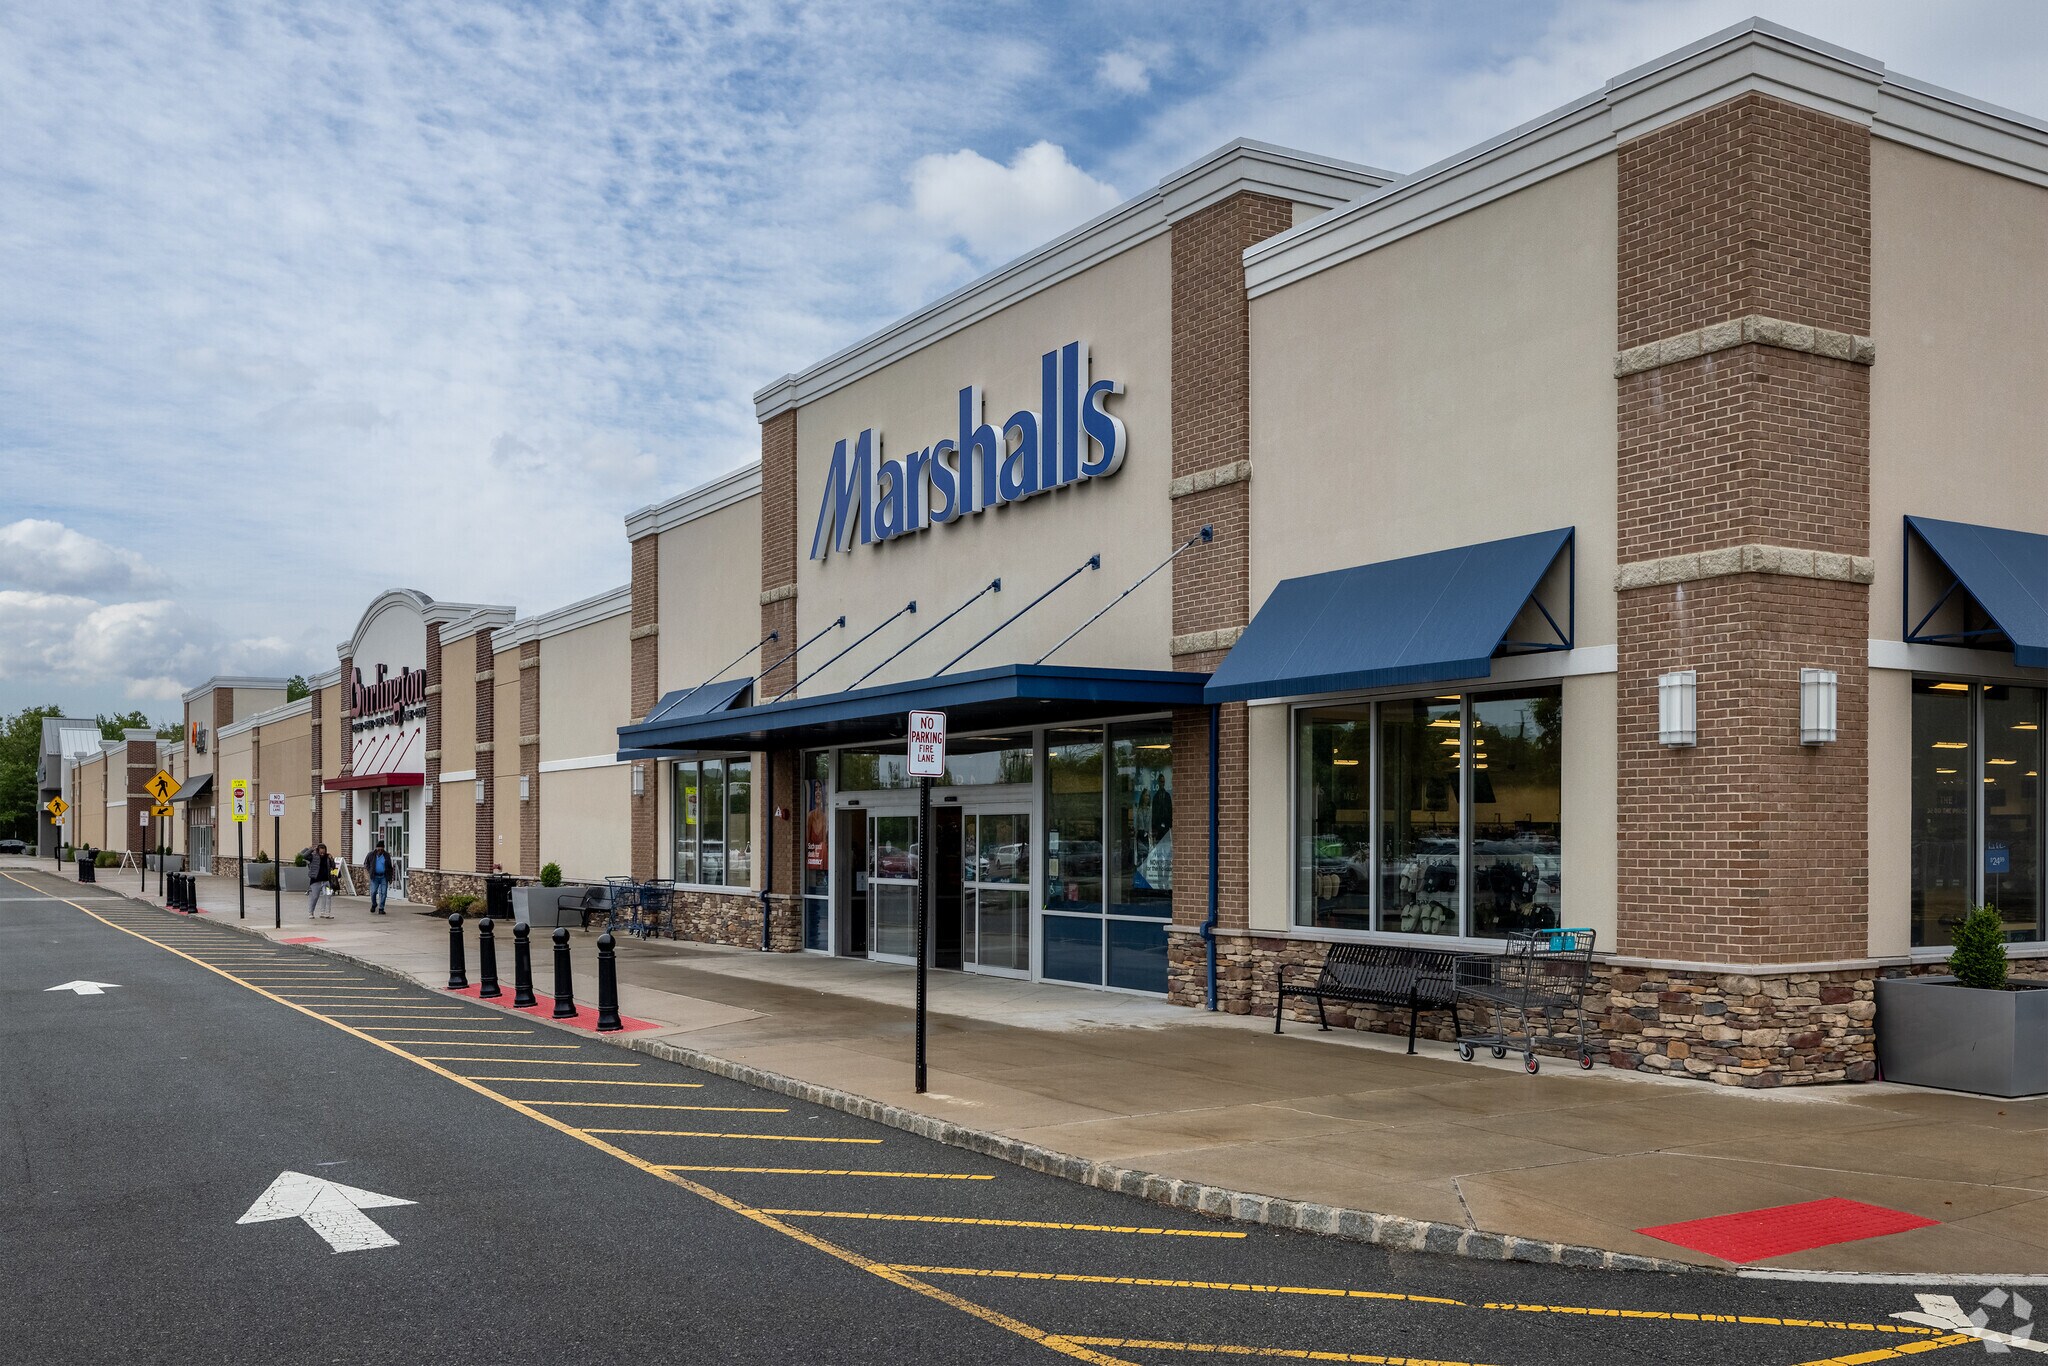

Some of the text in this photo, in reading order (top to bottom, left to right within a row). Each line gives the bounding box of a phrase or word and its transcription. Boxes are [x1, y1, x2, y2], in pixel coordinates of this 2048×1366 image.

[809, 339, 1127, 561] Marshalls
[350, 663, 427, 726] Burlington
[920, 717, 934, 730] NO
[911, 730, 943, 745] PARKING
[918, 744, 934, 754] FIRE
[917, 754, 935, 763] LANE
